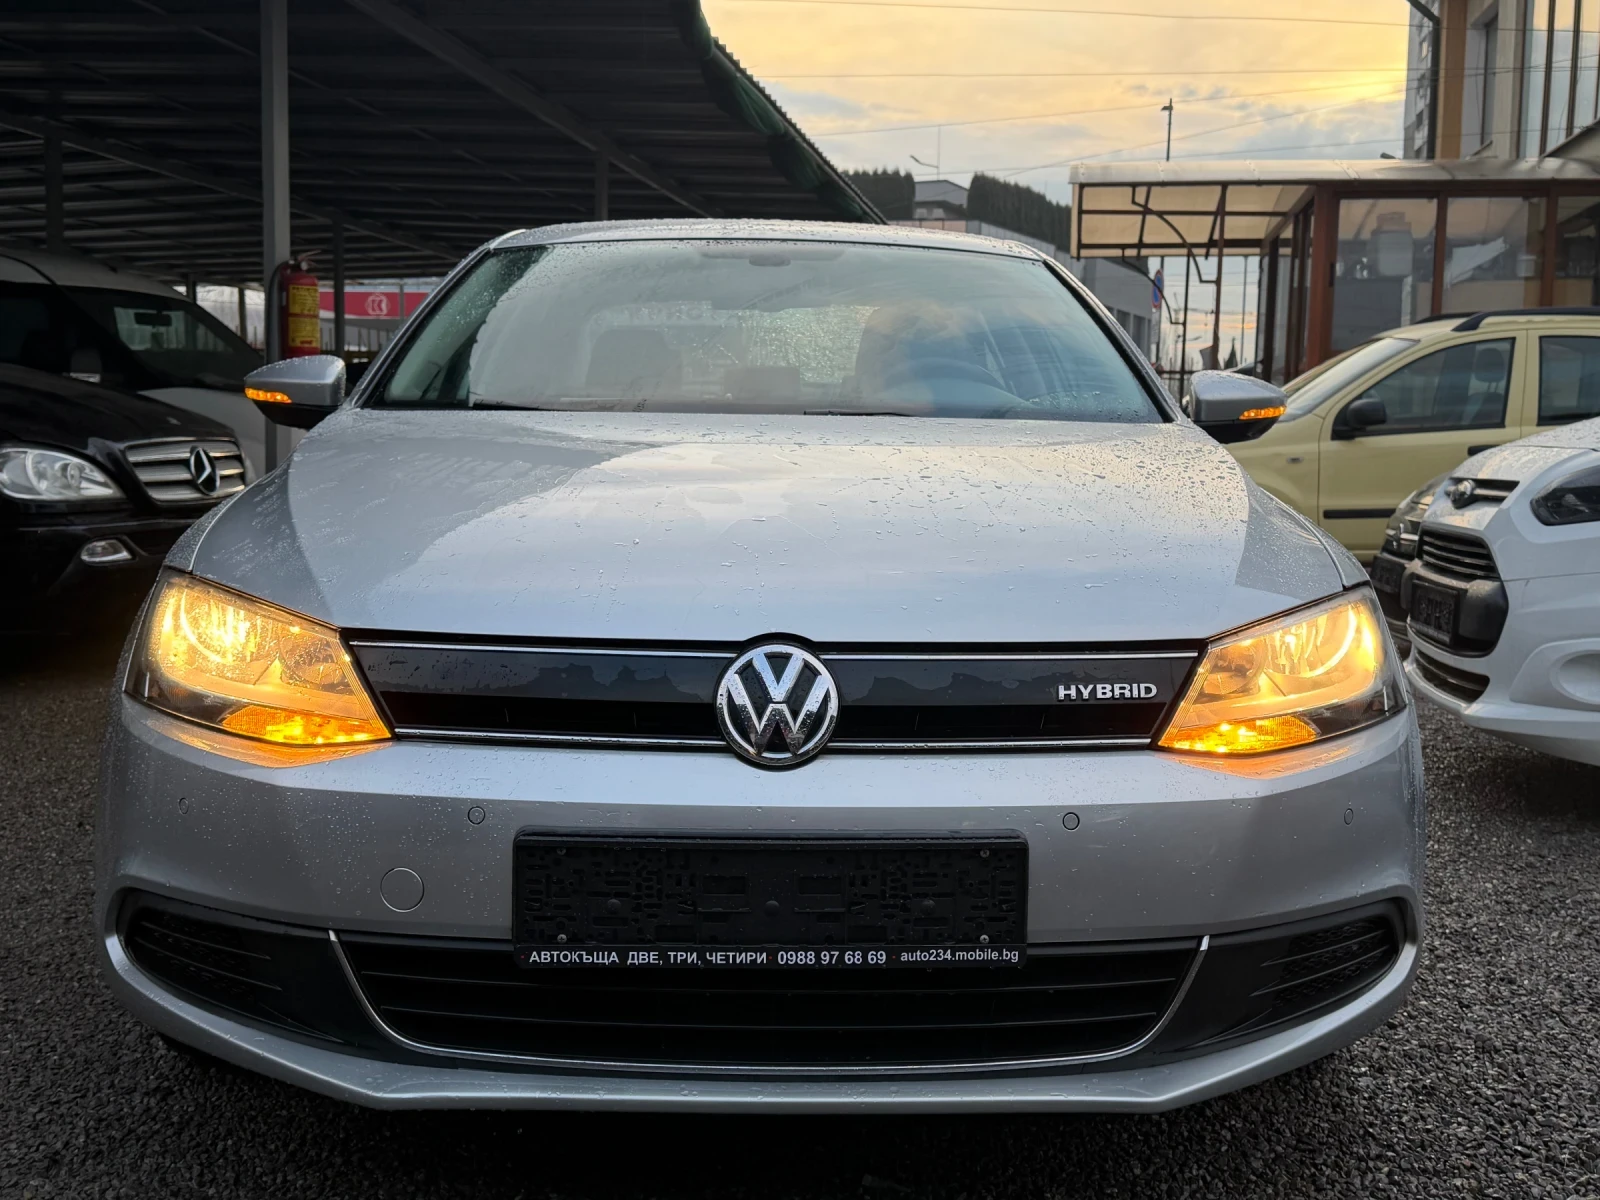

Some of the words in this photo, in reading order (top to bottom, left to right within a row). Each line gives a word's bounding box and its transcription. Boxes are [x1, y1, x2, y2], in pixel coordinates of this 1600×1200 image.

[1058, 683, 1158, 700] HYBRID
[528, 951, 620, 966] АВТОКЪЩА
[626, 951, 663, 966] ДВЕ,
[667, 951, 702, 966] ТРИ,
[705, 951, 768, 965] ЧЕТИРИ
[777, 950, 816, 965] 0988
[820, 950, 840, 965] 97
[844, 950, 863, 965] 68
[867, 950, 887, 965] 69
[900, 948, 1019, 963] auto234.mobile.bg
